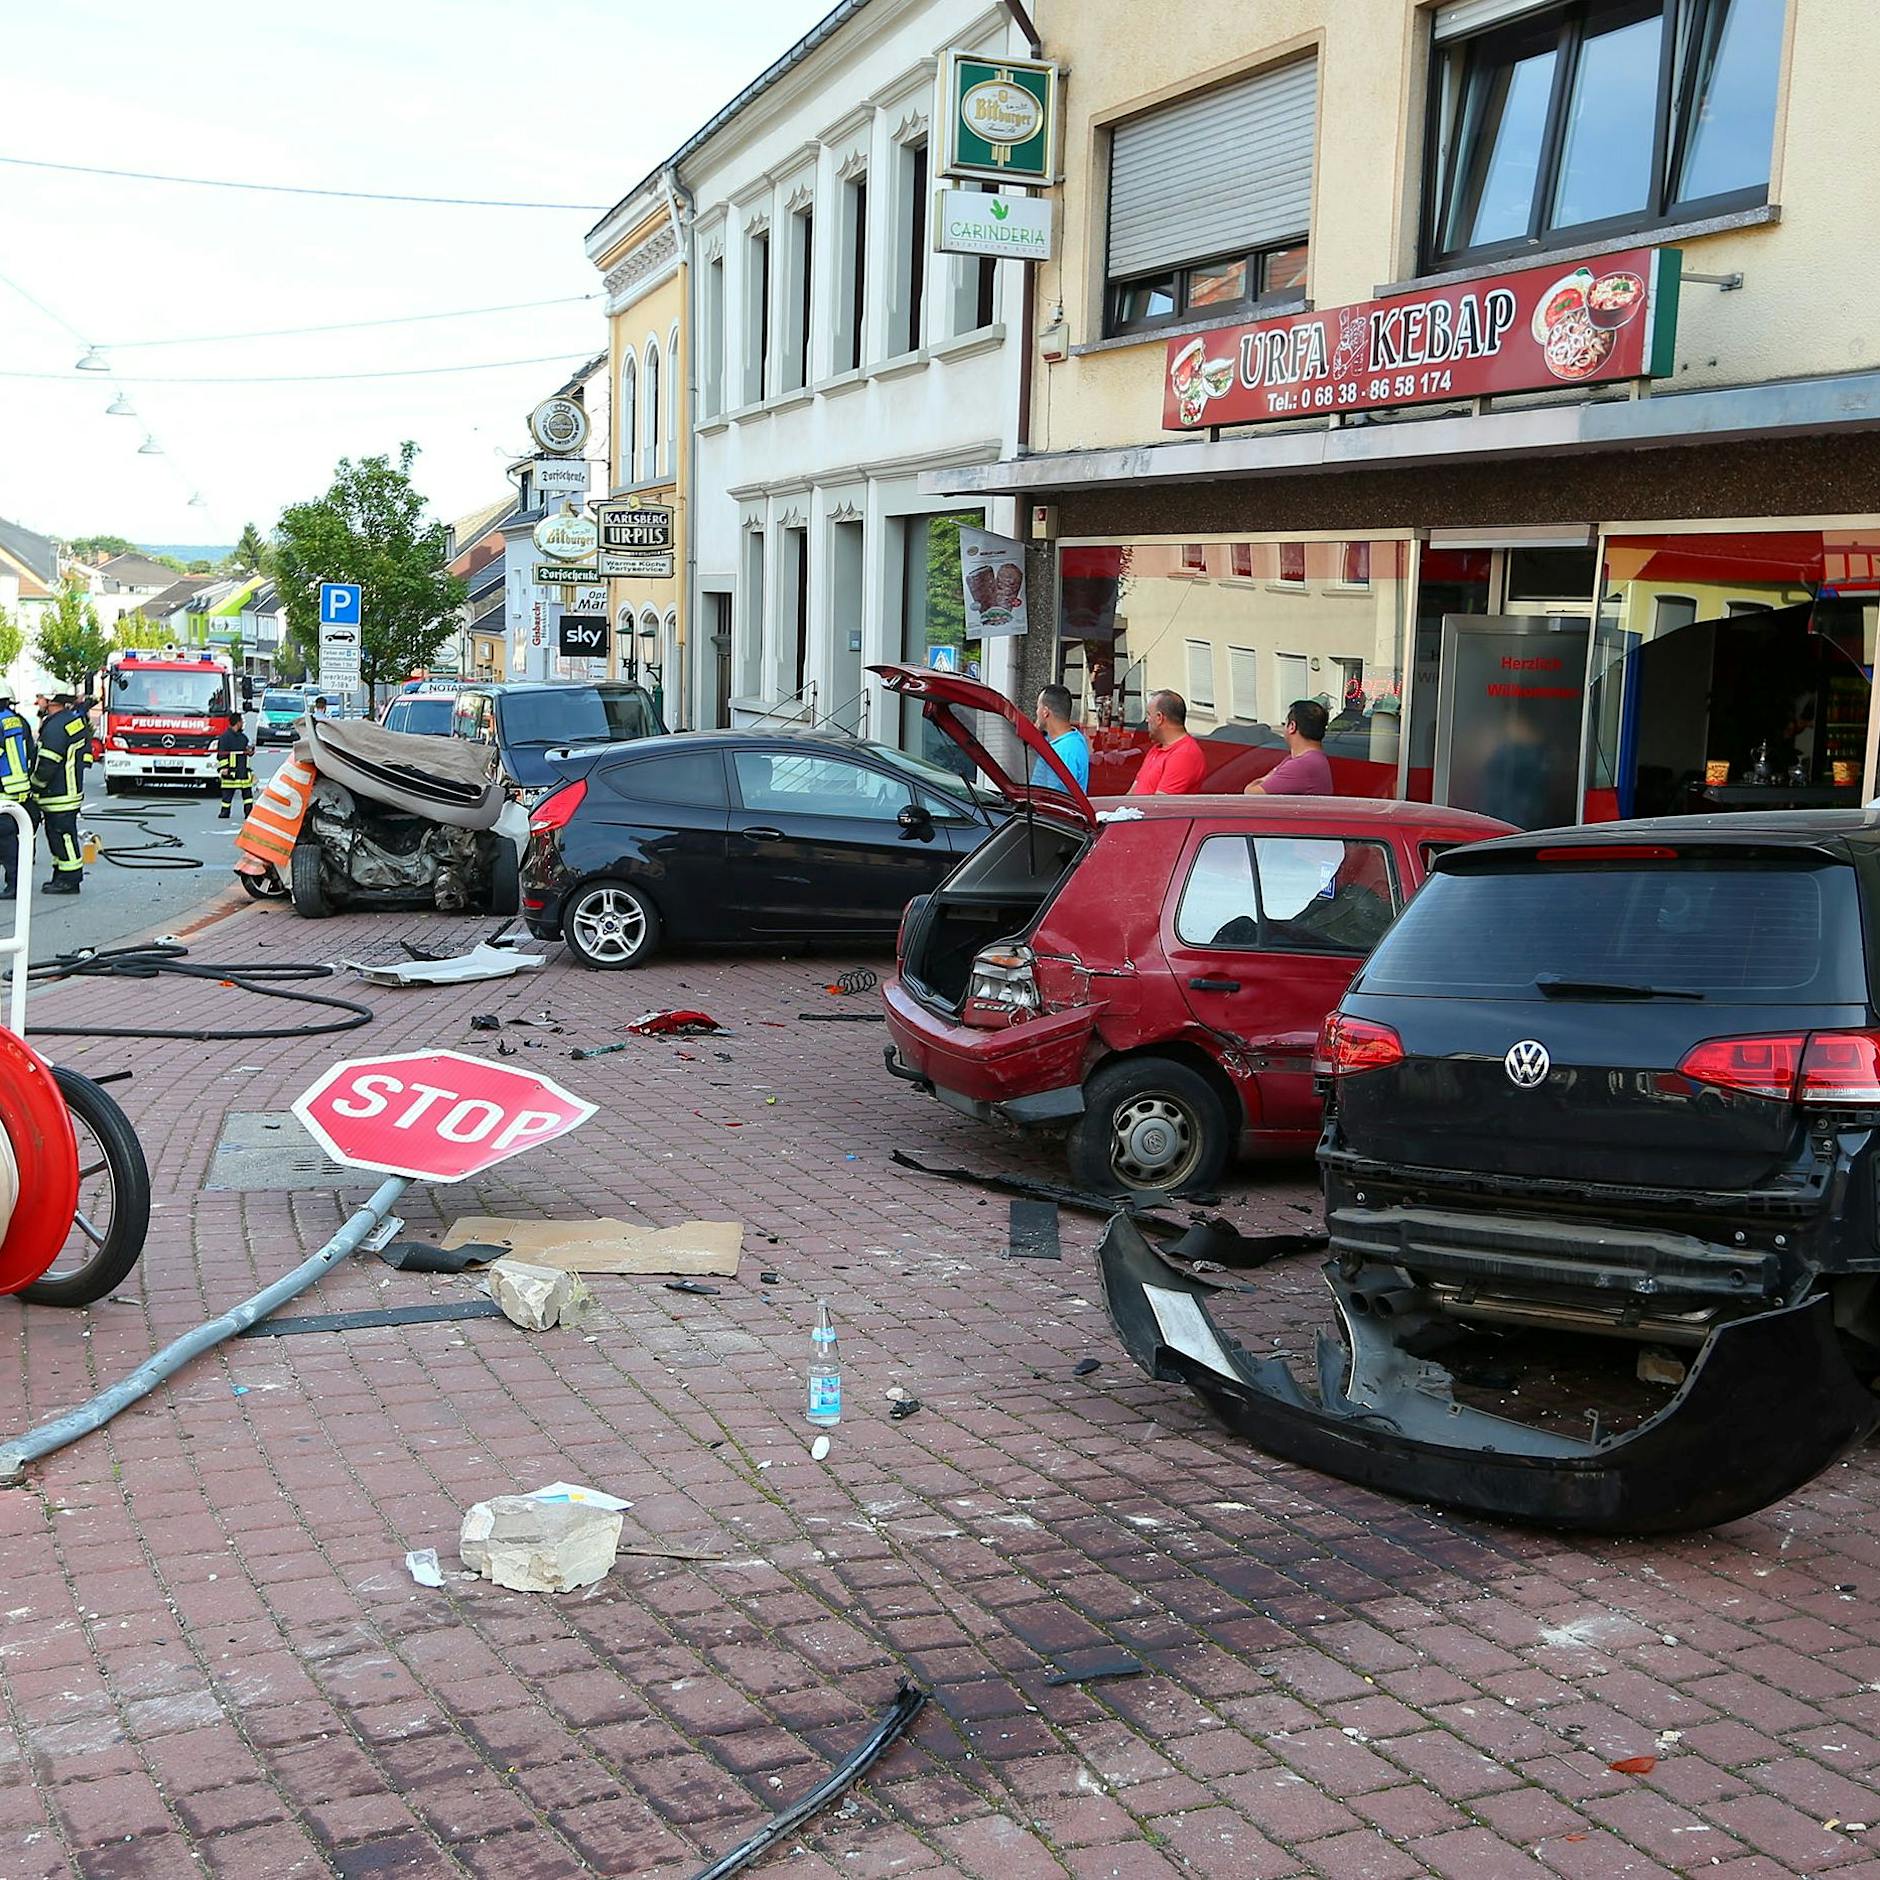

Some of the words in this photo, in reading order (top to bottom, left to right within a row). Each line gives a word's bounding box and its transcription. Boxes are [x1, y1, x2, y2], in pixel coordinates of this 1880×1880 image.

[975, 98, 1031, 127] Bitburger
[951, 222, 1045, 245] CARINDERIA
[1240, 321, 1330, 389] URFA
[1368, 288, 1517, 373] KEBAP
[1267, 391, 1297, 412] Tel.:
[1301, 388, 1311, 408] 0
[1315, 385, 1334, 406] 68
[1338, 382, 1358, 404] 38
[1369, 378, 1390, 400] 86
[1394, 375, 1415, 397] 58
[1420, 370, 1452, 394] 174
[604, 512, 668, 525] KARLSBERG
[545, 528, 595, 547] Bitburger
[609, 527, 664, 545] UR-PILS
[329, 589, 352, 618] P
[566, 625, 602, 647] sky
[1501, 656, 1563, 671] Herzlich
[132, 718, 205, 729] FEUERWEHR
[331, 1074, 562, 1150] STOP
